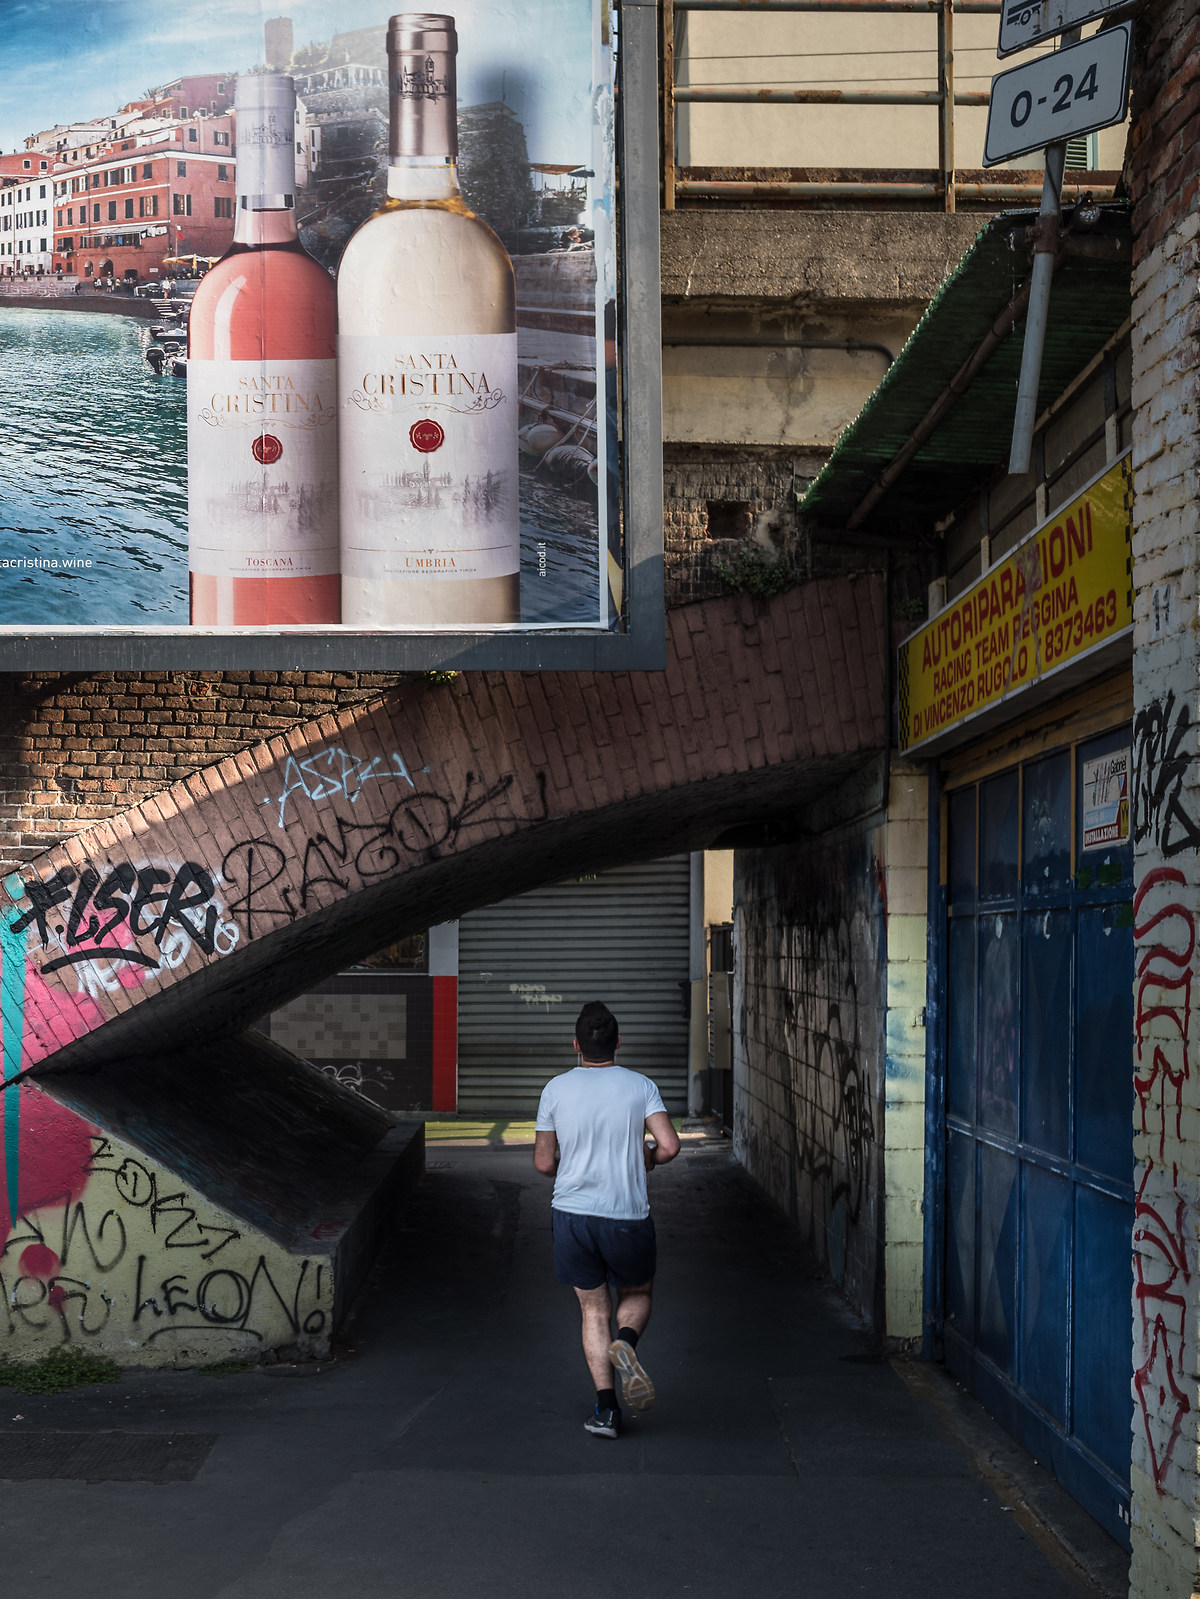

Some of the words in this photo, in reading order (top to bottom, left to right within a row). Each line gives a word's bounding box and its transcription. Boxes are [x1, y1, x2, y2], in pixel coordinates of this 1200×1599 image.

[1010, 62, 1098, 128] 0-24
[395, 353, 458, 369] SANTA
[239, 375, 295, 390] SANTA
[362, 372, 491, 395] CRISTINA
[211, 392, 323, 413] CRISTINA
[536, 542, 547, 577] aicod.it
[913, 714, 923, 738] DI
[924, 685, 975, 732] VINCENZO
[978, 646, 1028, 702] RUGOLO
[1045, 589, 1118, 663] 8373463
[934, 650, 972, 697] RACING
[975, 621, 1009, 669] TEAM
